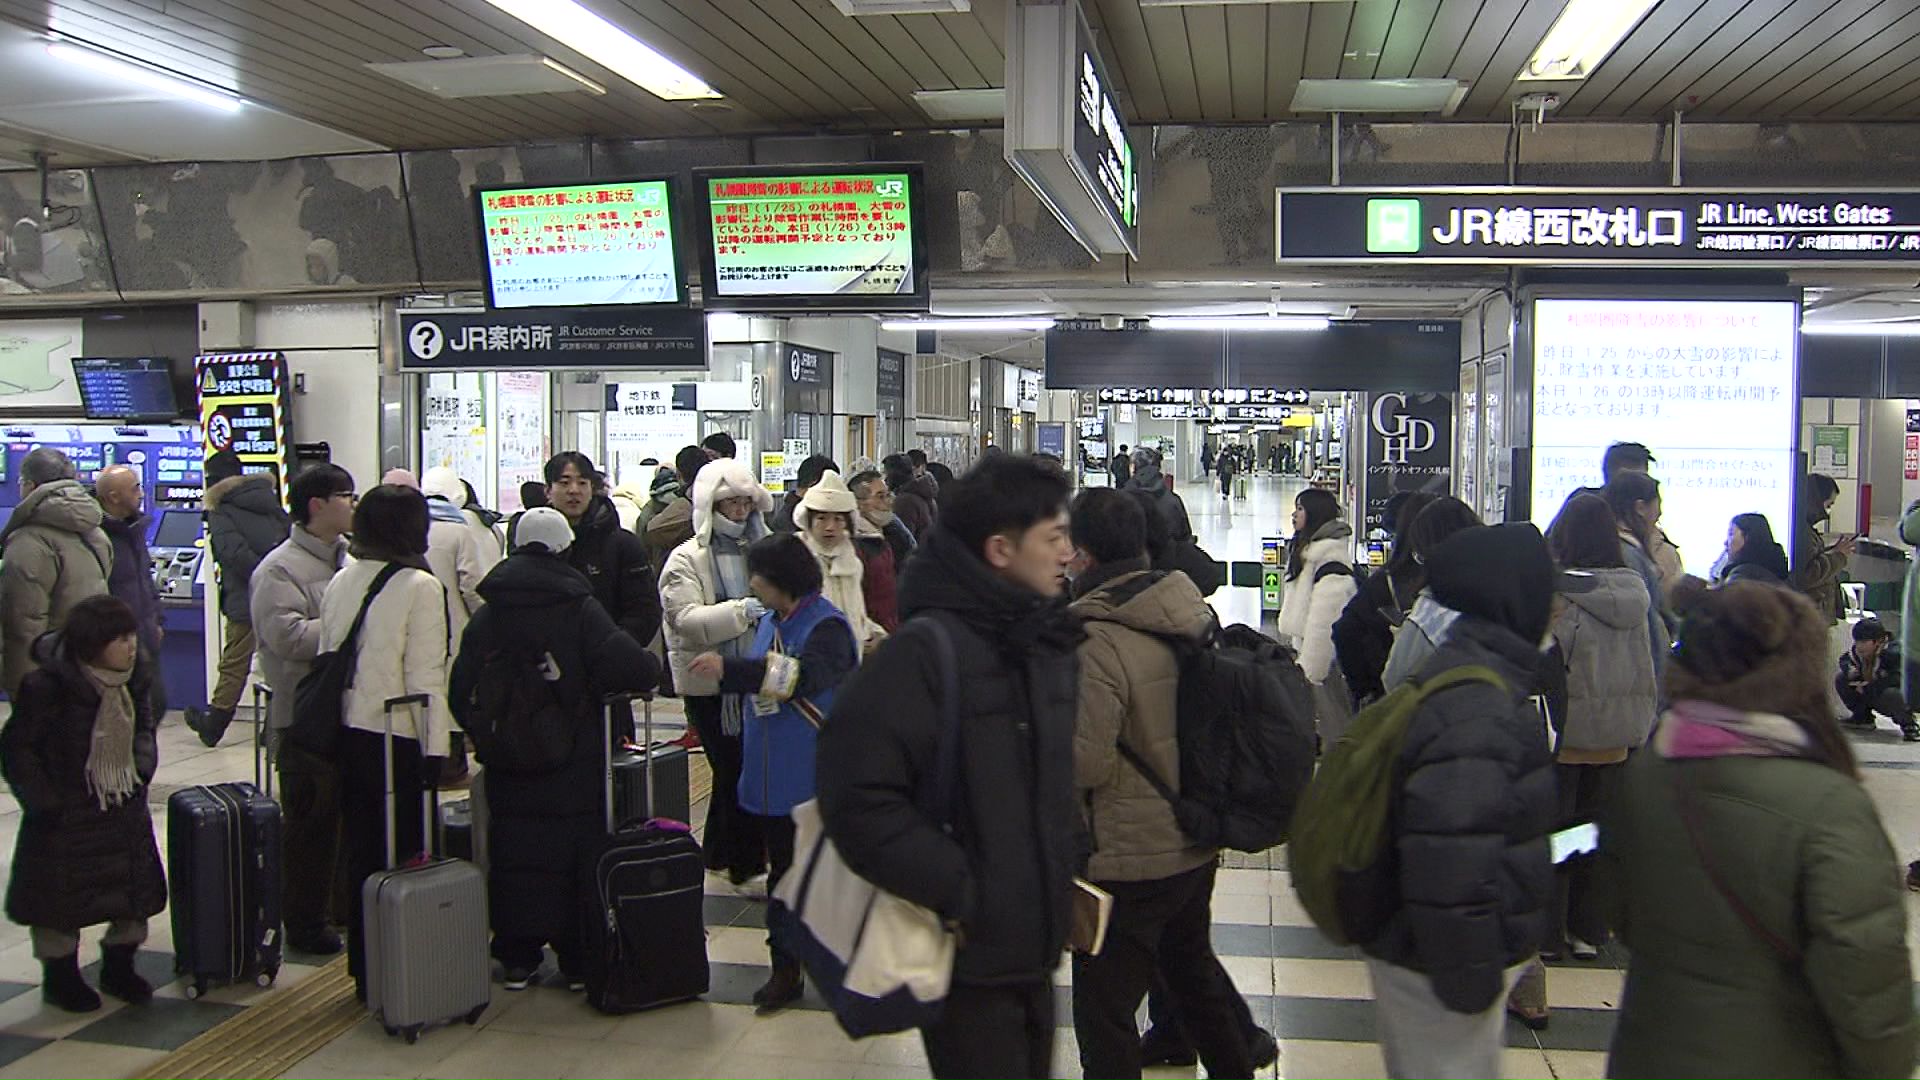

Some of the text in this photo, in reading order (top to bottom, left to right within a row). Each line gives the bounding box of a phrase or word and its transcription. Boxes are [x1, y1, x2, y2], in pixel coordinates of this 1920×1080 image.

[1696, 202, 1892, 226] JR Line, West Gates
[1432, 206, 1685, 246] JR線西改札口
[450, 325, 553, 351] JR案内所
[558, 324, 653, 337] JR Customer Service
[628, 390, 661, 401] 地下鉄
[624, 405, 667, 416] 代替窓口
